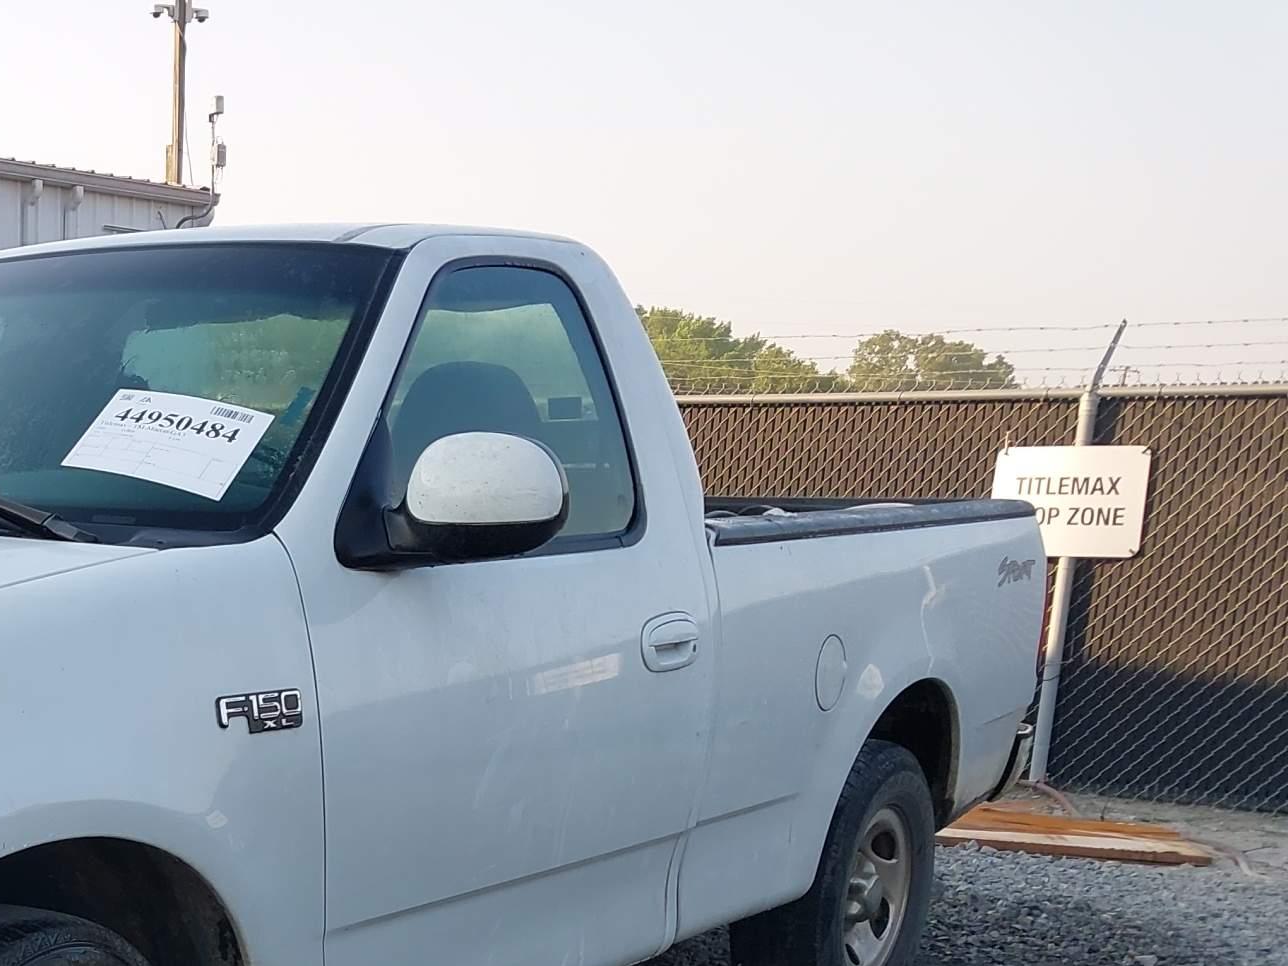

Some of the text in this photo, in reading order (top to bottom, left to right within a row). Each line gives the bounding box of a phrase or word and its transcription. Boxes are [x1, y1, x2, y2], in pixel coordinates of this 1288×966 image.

[115, 407, 242, 443] 44950484
[1016, 476, 1123, 496] TITLEMAX
[1036, 507, 1126, 526] OP ZONE
